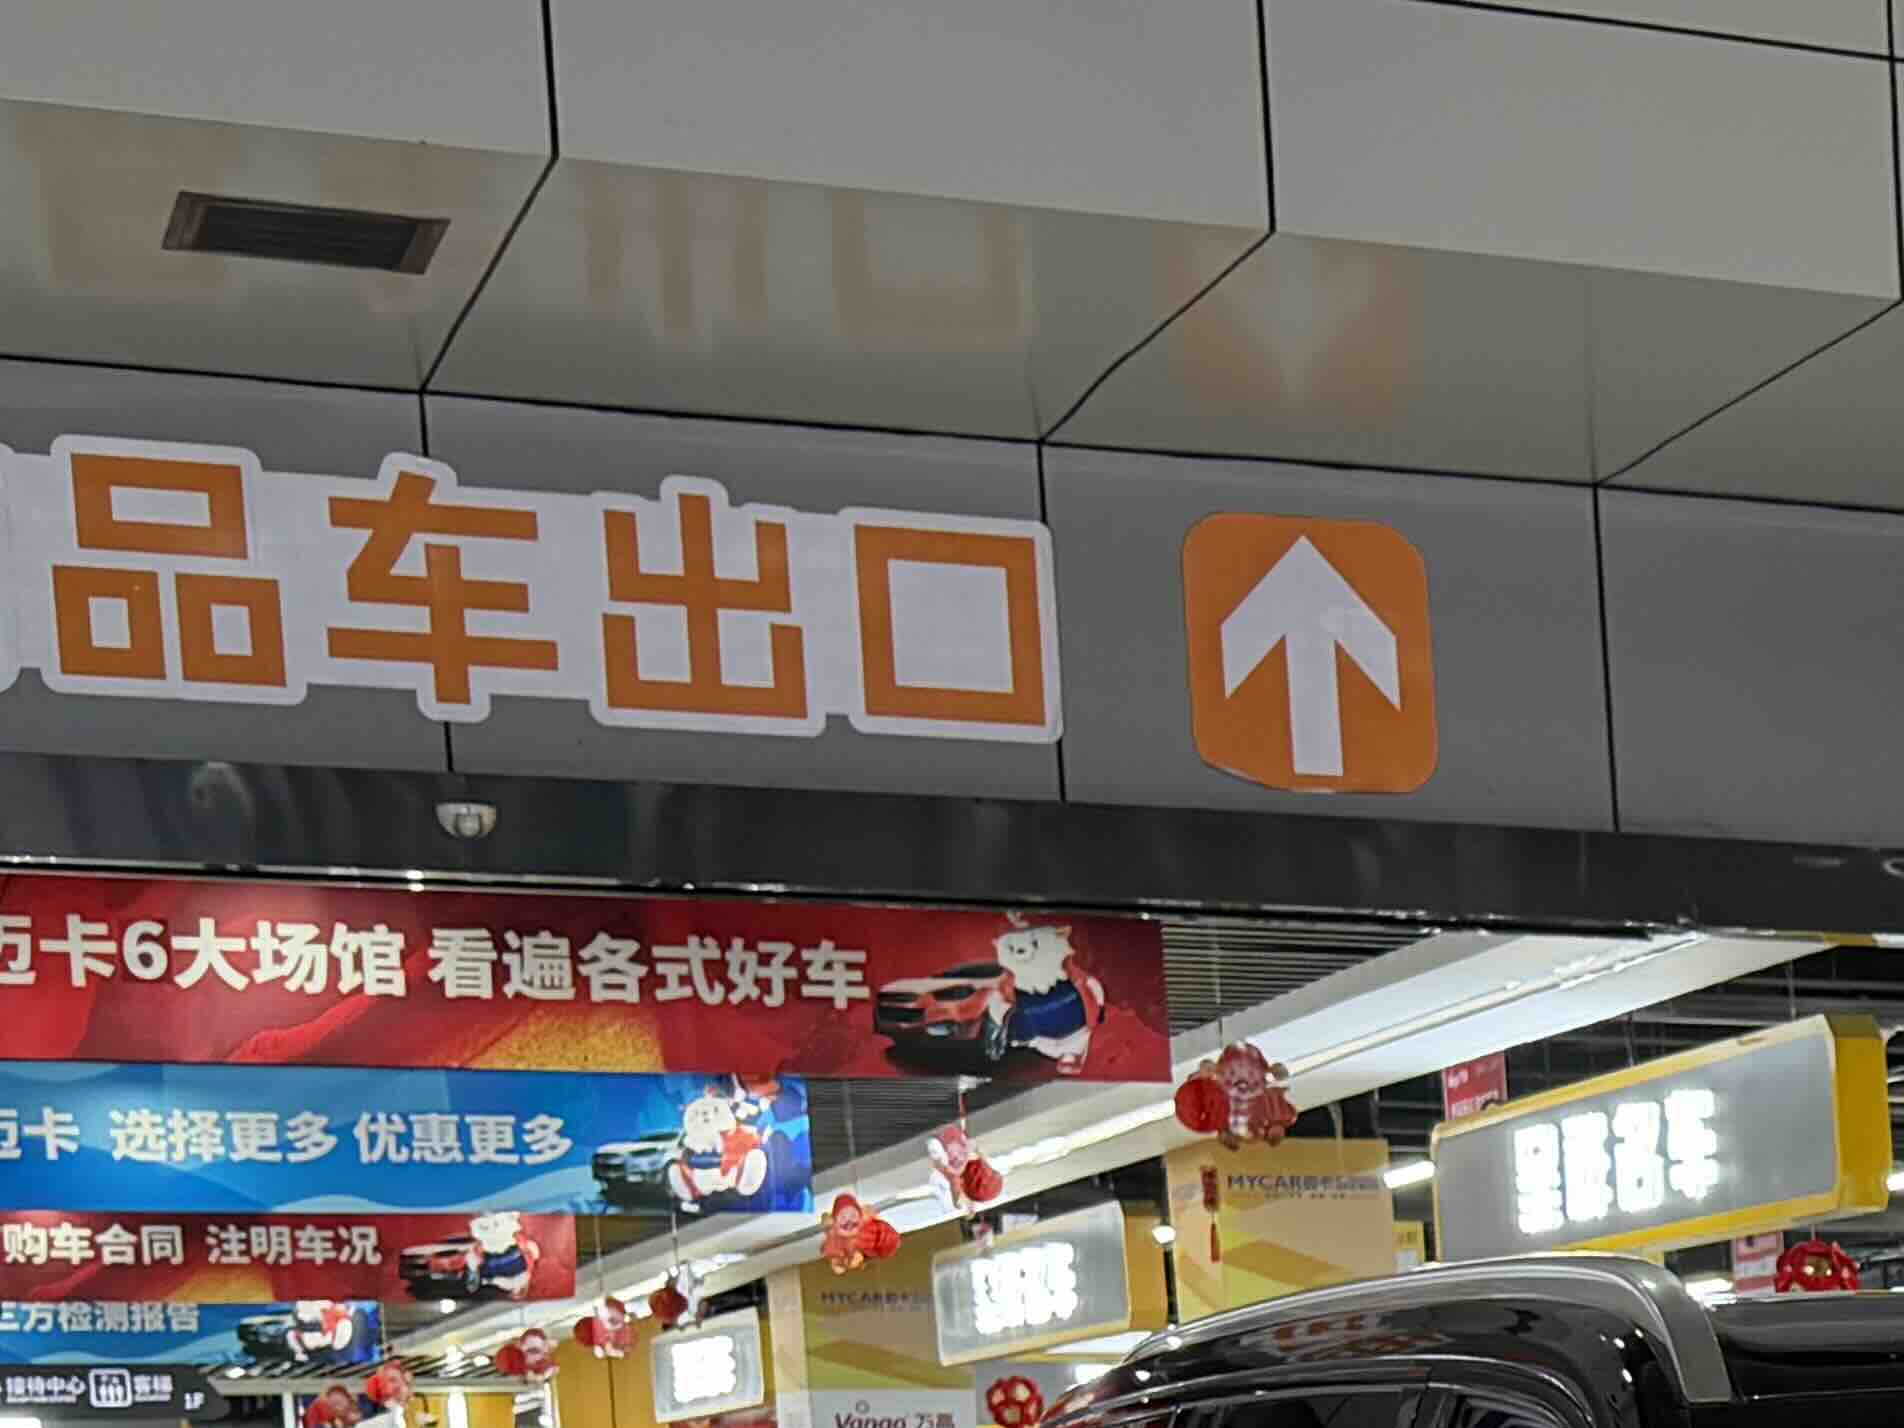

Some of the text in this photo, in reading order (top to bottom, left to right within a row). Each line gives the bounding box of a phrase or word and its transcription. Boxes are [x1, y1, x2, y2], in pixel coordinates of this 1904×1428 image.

[51, 450, 1048, 728] 品车出口
[428, 926, 872, 1011] 看遍各式好车
[110, 1108, 338, 1164] 选择更多
[352, 1110, 576, 1166] 优惠更多
[2, 1221, 383, 1266] 购车合同 注明车况
